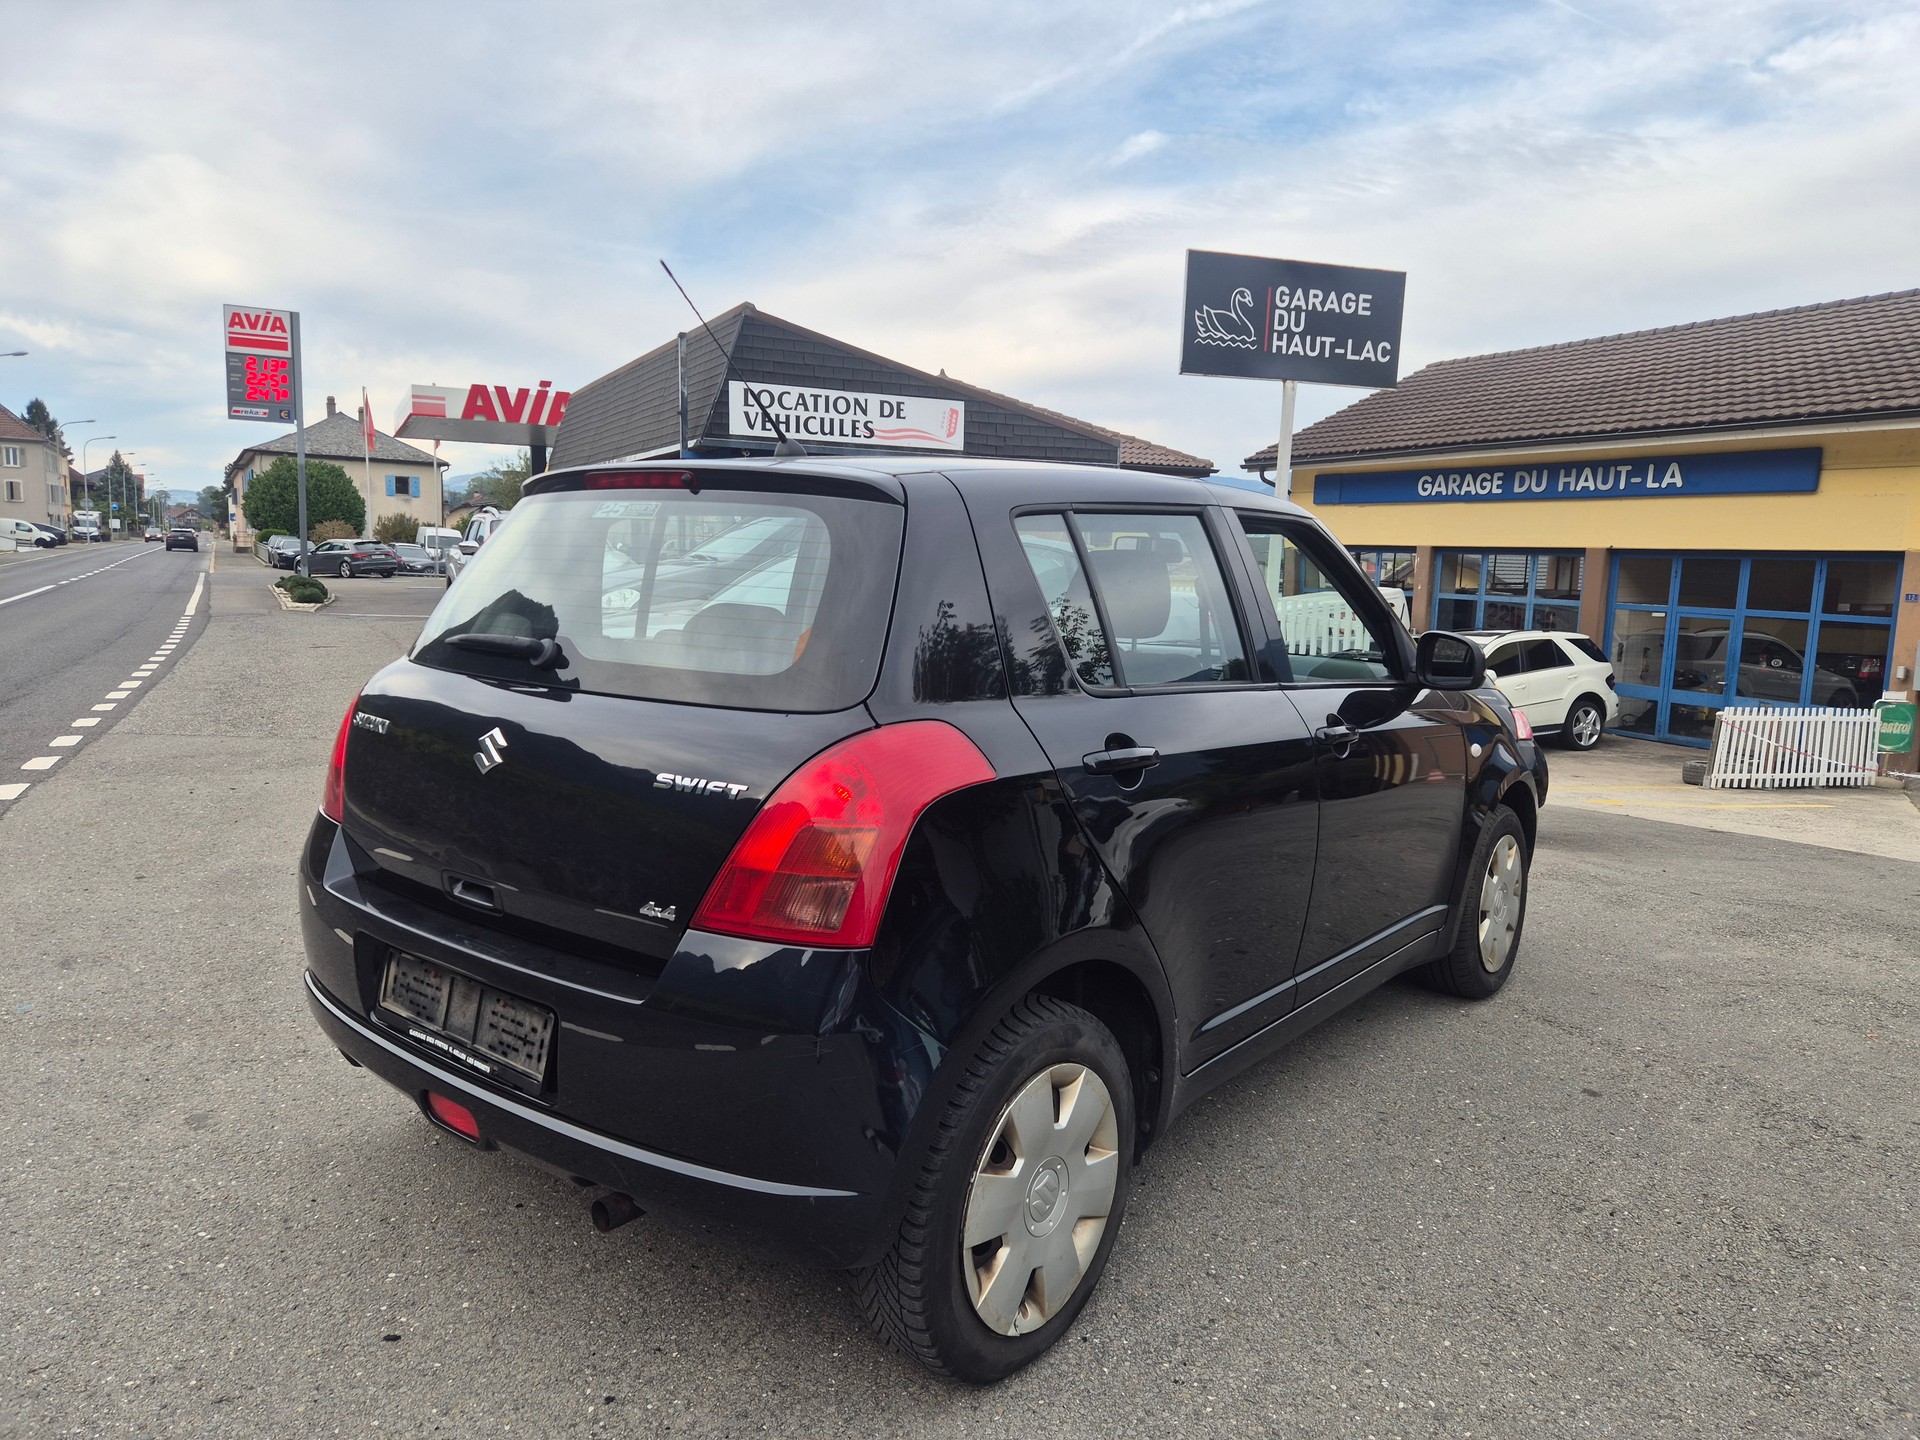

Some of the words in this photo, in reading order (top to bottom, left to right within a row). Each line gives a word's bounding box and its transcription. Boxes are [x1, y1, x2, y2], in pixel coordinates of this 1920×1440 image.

[1275, 286, 1372, 316] GARAGE
[1273, 309, 1306, 333] DU
[1272, 332, 1391, 363] HAUT-LAC
[743, 387, 868, 417] LOCATION
[879, 399, 906, 420] DE
[743, 411, 875, 439] VEHICULES
[1417, 472, 1504, 497] GARAGE
[1513, 468, 1549, 493] DU
[1557, 462, 1683, 492] HAUT-LA
[652, 772, 749, 800] SWIFT
